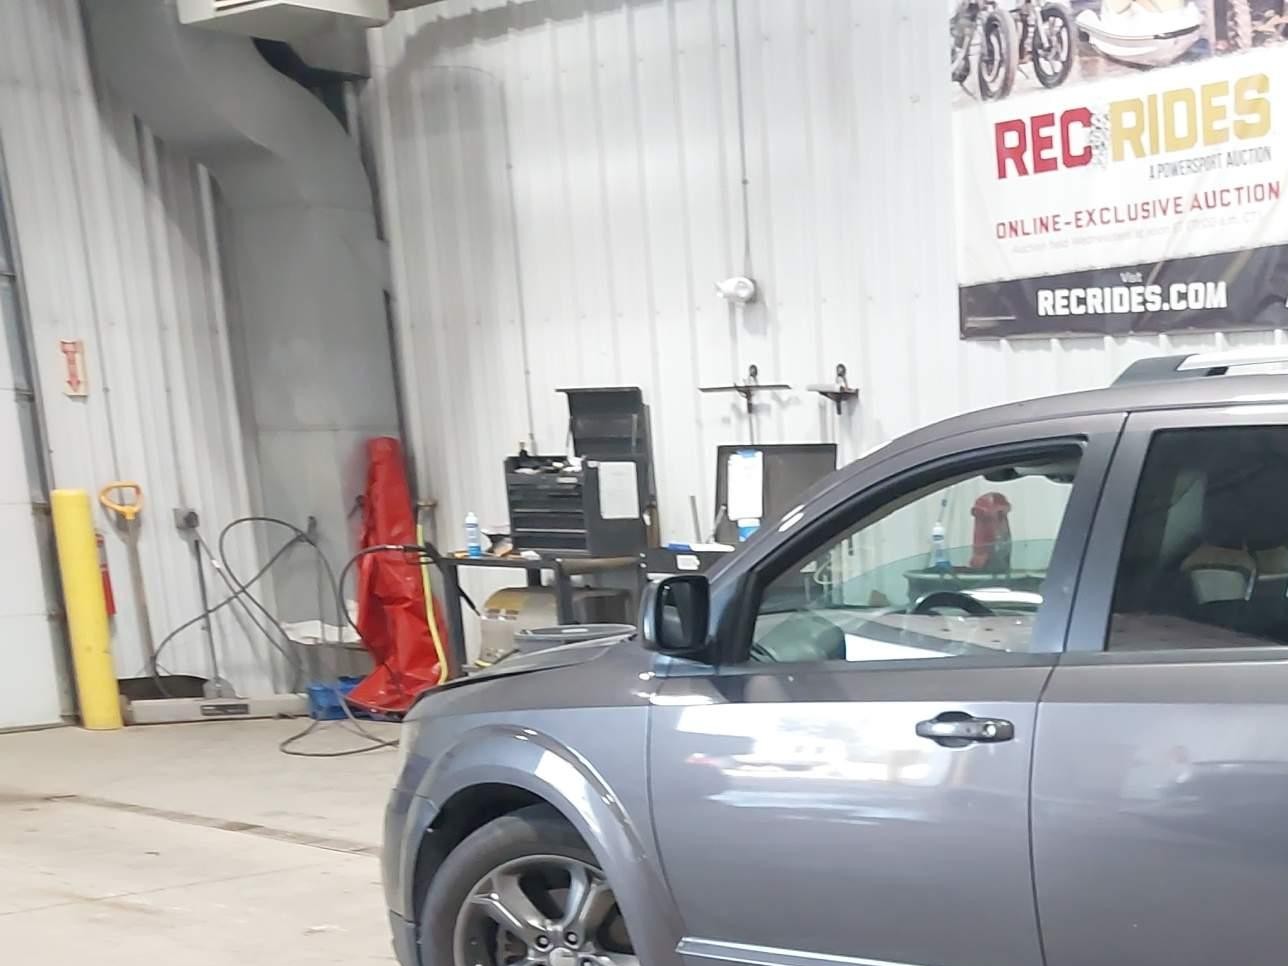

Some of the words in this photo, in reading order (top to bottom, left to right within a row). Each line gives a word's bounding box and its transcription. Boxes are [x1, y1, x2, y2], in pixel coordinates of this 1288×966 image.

[995, 106, 1094, 180] REC
[1110, 73, 1271, 162] RIDES
[1157, 153, 1222, 178] POWERSPORT
[1226, 146, 1272, 167] AUCTION
[996, 197, 1183, 240] ONLINE-EXCLUSIVE
[1190, 181, 1281, 212] AUCTION
[1037, 281, 1228, 317] RECRIDES.COM
